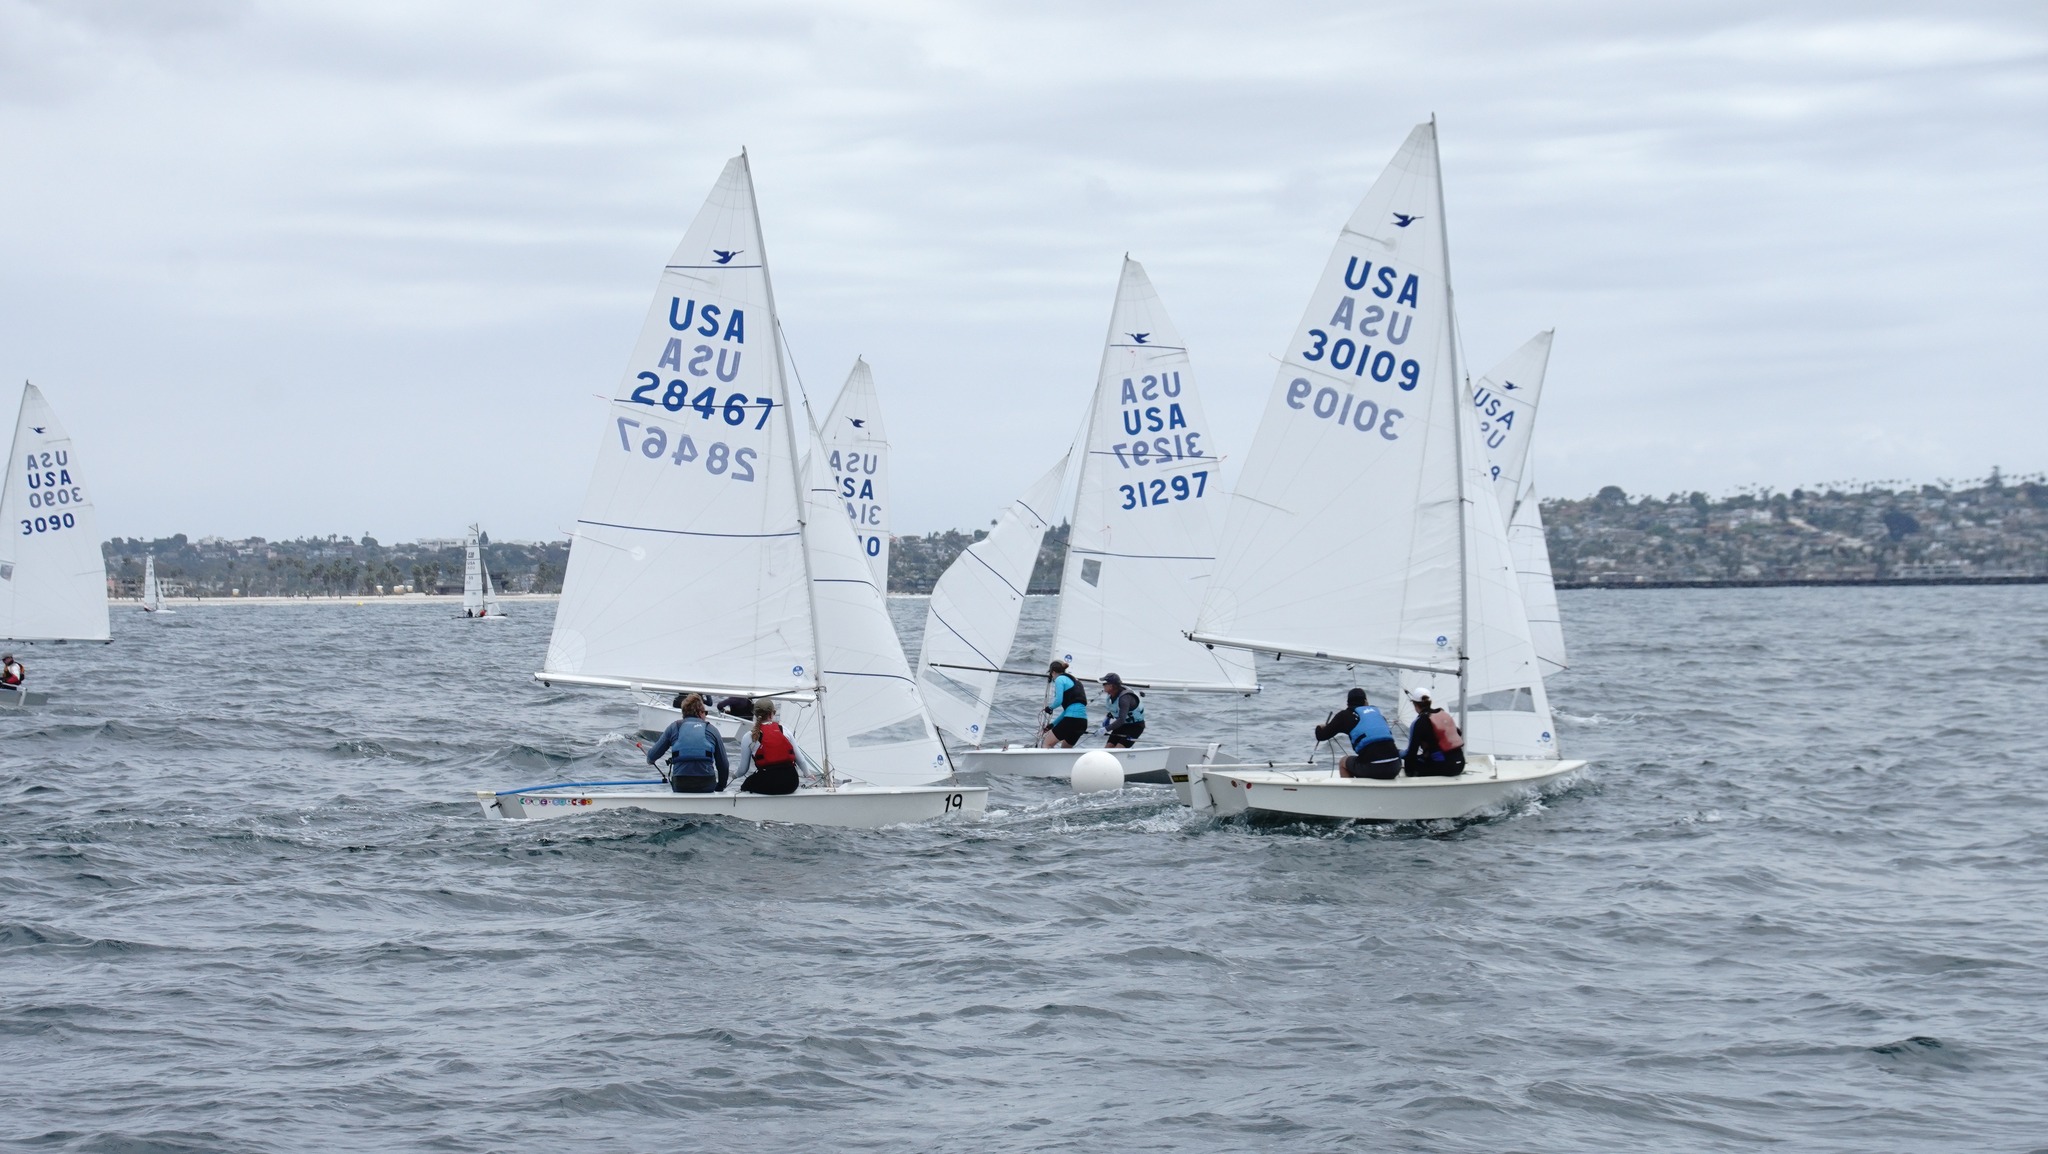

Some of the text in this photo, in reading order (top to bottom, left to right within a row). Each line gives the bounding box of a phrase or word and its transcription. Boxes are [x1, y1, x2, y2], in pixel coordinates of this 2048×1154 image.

[1344, 255, 1420, 309] USA
[669, 296, 745, 344] USA
[1302, 329, 1421, 391] 30109
[631, 371, 774, 430] 28467
[1121, 403, 1187, 435] USA
[1474, 388, 1515, 430] USA
[27, 469, 72, 489] USA
[835, 475, 873, 500] SA
[1119, 471, 1209, 510] 31297
[21, 513, 75, 535] 3090
[945, 794, 963, 813] 19
